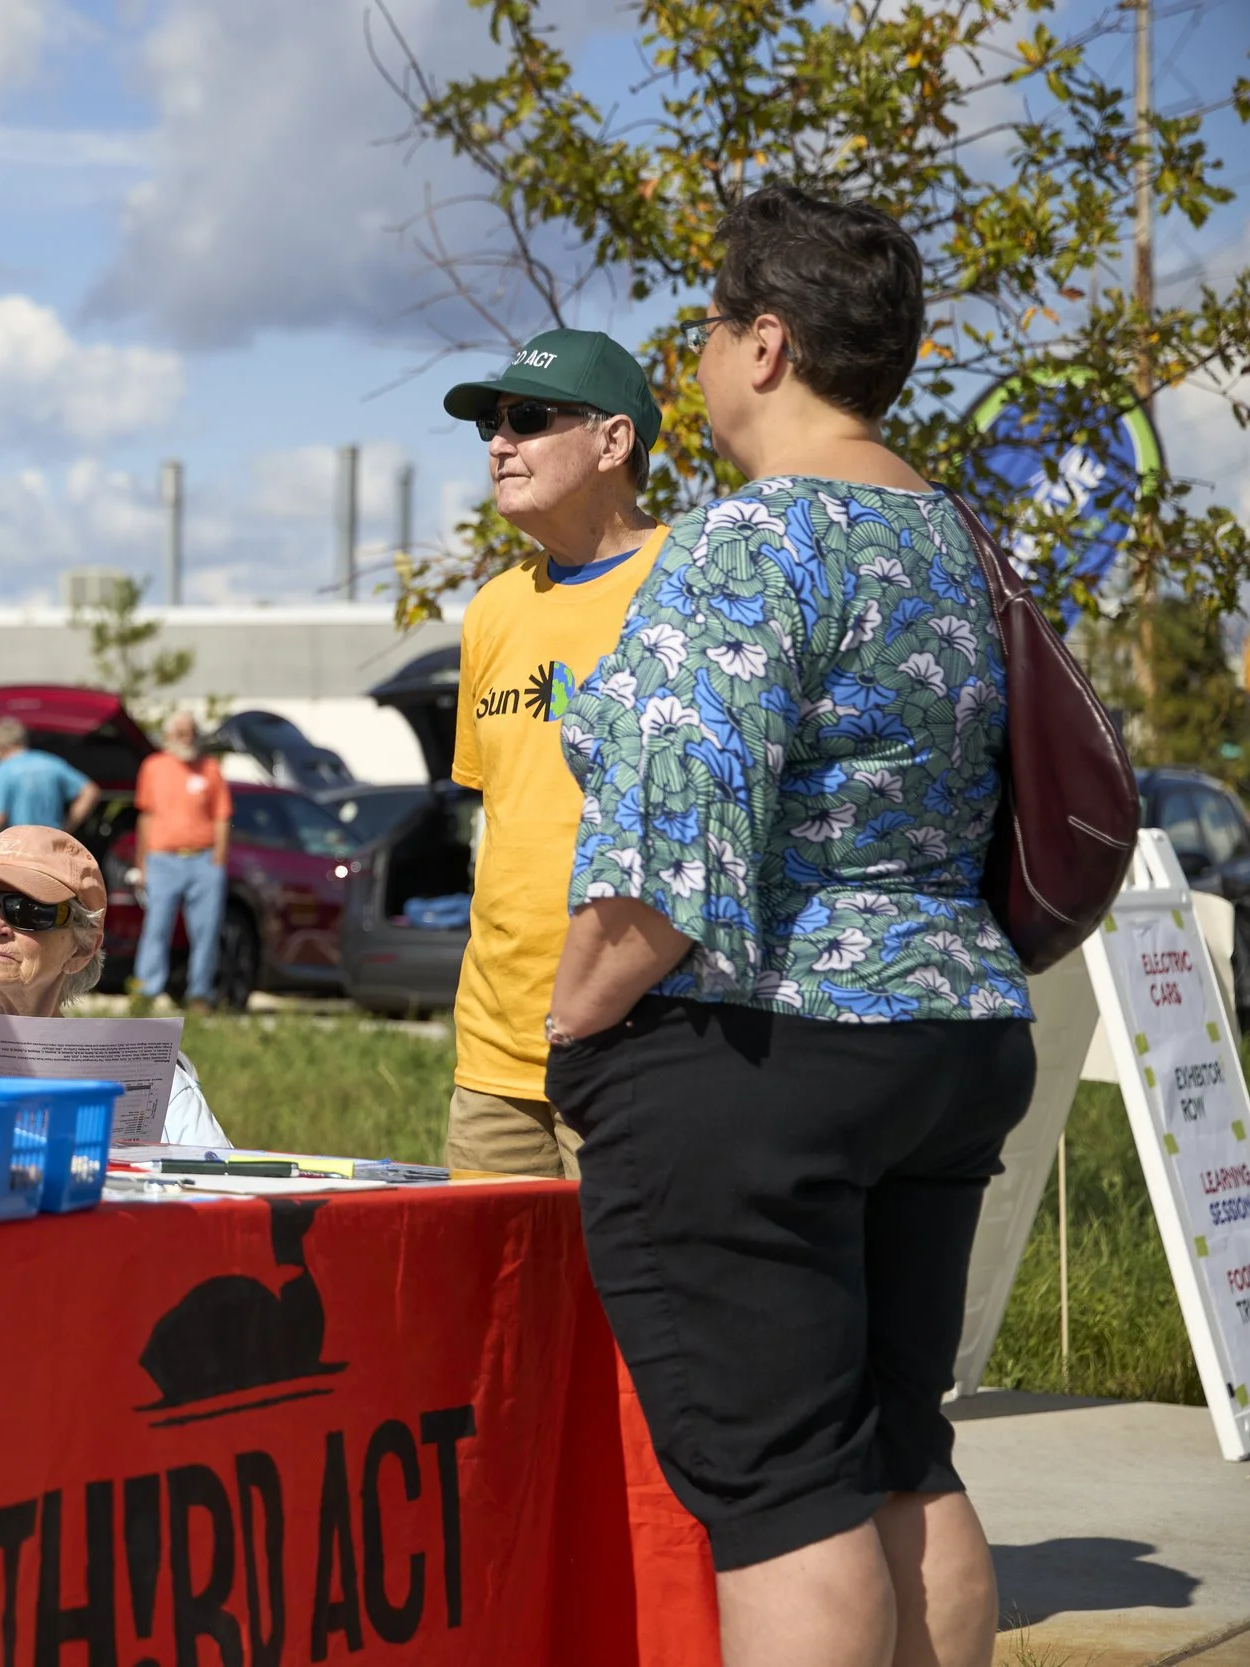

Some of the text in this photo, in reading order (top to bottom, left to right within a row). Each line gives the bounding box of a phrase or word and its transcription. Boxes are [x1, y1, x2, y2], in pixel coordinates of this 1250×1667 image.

[524, 349, 558, 368] ACT
[1141, 950, 1192, 976] ELECTRIC
[1150, 982, 1182, 1007] CARS
[1175, 1061, 1224, 1091] EXHIBITOR
[1181, 1097, 1207, 1122] ROW
[311, 1404, 476, 1663] ACT
